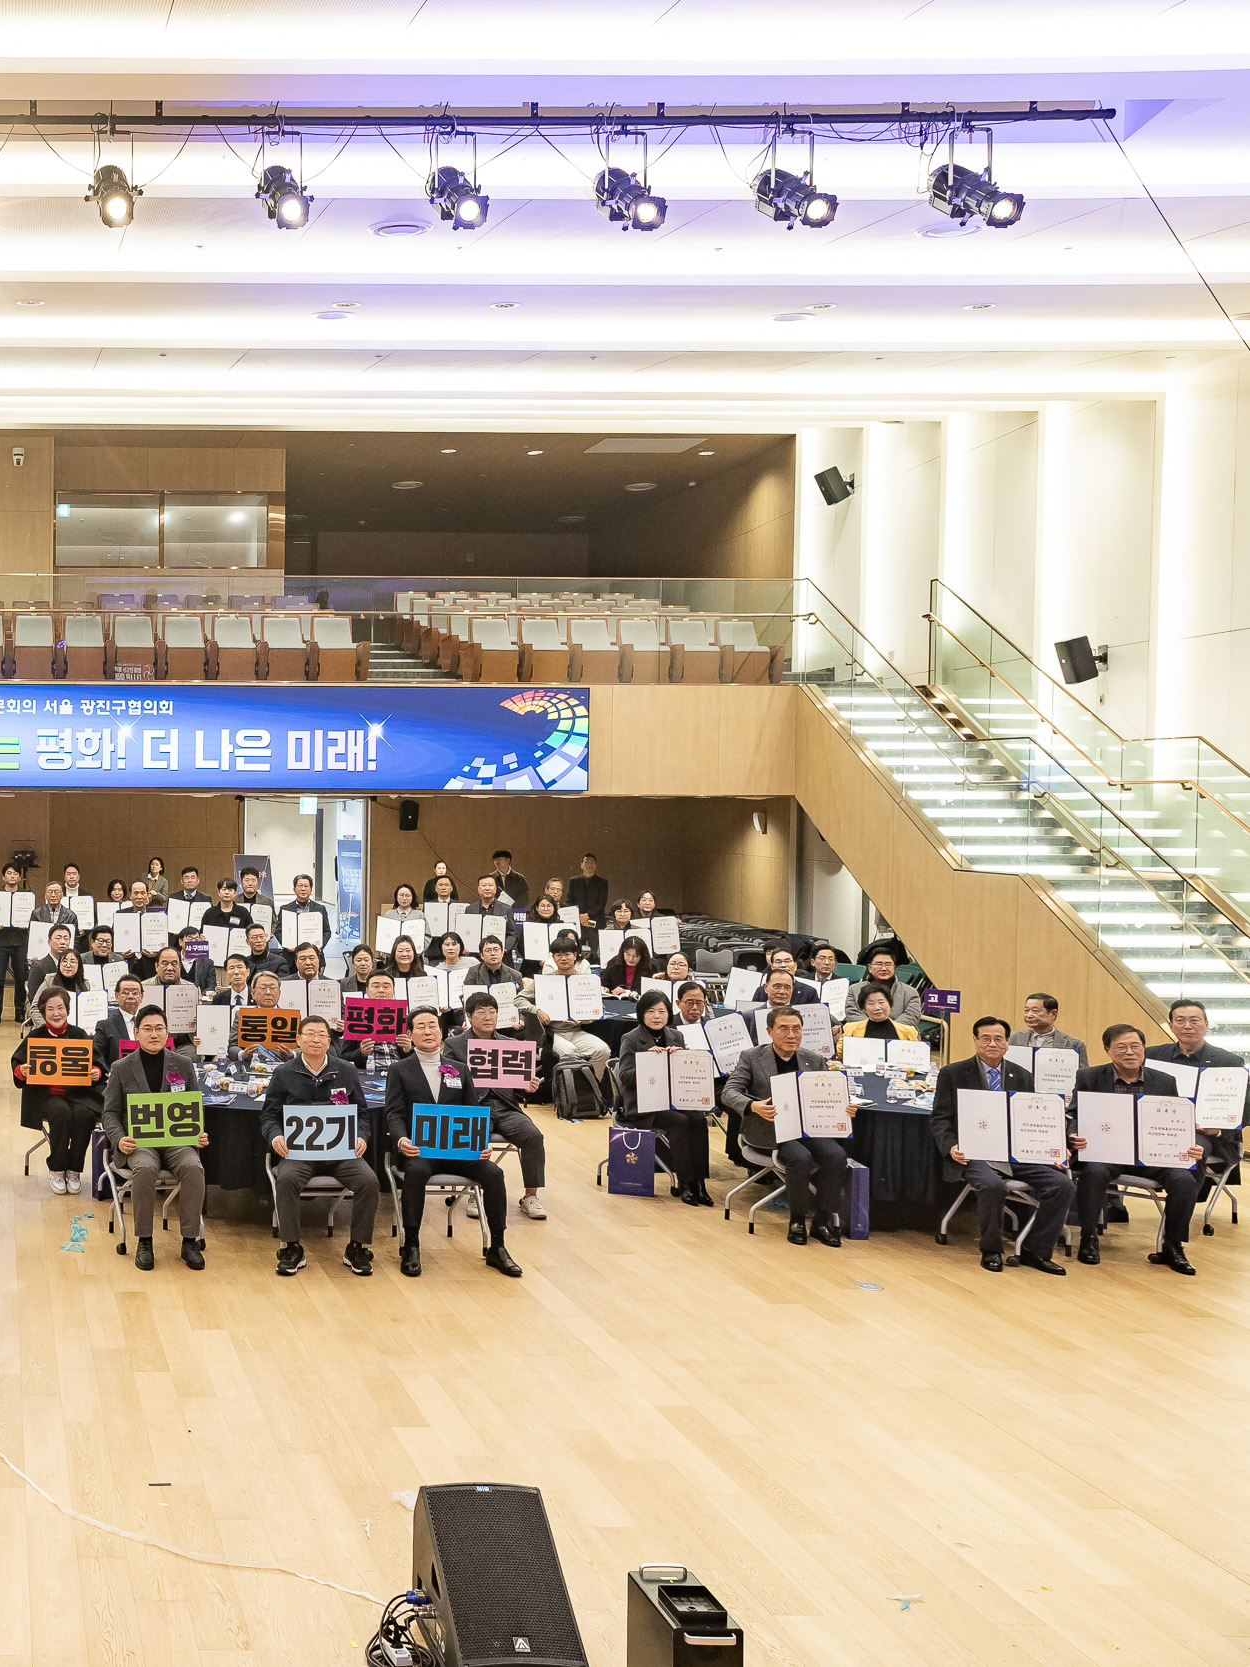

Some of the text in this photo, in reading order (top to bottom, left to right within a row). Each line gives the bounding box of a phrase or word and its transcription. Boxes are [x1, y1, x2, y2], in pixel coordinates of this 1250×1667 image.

[43, 698, 74, 716] 서울
[80, 698, 174, 716] 광진구협의회
[35, 727, 127, 772] 평화!
[142, 728, 179, 772] 더
[195, 728, 273, 772] 나은
[286, 727, 379, 773] 미래!
[513, 912, 526, 921] 위원
[240, 1015, 299, 1044] 통일
[346, 1006, 407, 1035] 평화
[468, 1047, 533, 1082] 협력
[130, 1101, 201, 1139] 번영
[285, 1115, 355, 1151] 22기
[415, 1114, 488, 1152] 미래
